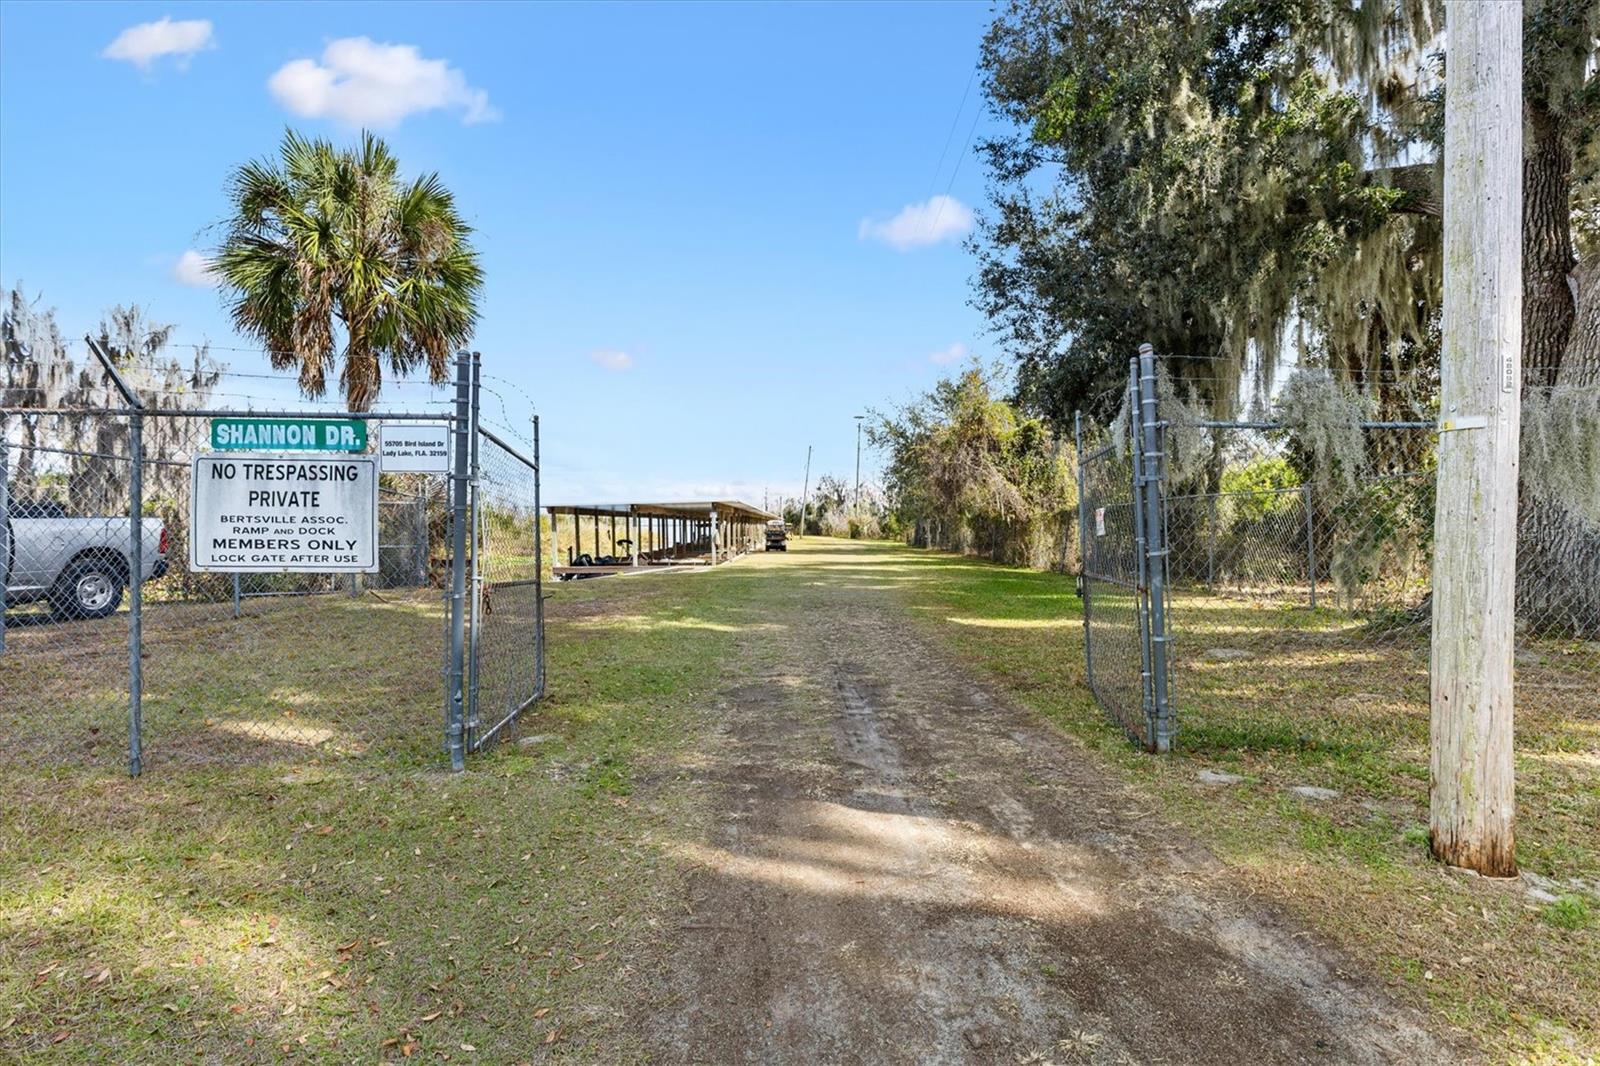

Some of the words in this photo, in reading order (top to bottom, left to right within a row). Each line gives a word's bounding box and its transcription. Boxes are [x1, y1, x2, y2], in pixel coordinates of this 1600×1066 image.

[216, 424, 315, 445] SHANNON
[326, 426, 361, 446] DR.
[212, 464, 236, 479] NO
[243, 464, 358, 482] TRESPASSING
[249, 491, 320, 507] PRIVATE
[221, 515, 296, 524] BERTSVILLE
[301, 516, 348, 524] ASSOC.
[233, 527, 269, 535] RAMP
[299, 527, 335, 535] DOCK
[213, 539, 300, 549] MEMBERS
[308, 540, 357, 550] ONLY
[212, 554, 246, 562] LOCK
[252, 554, 285, 563] GATE
[290, 555, 329, 563] AFTER
[334, 555, 358, 563] USE
